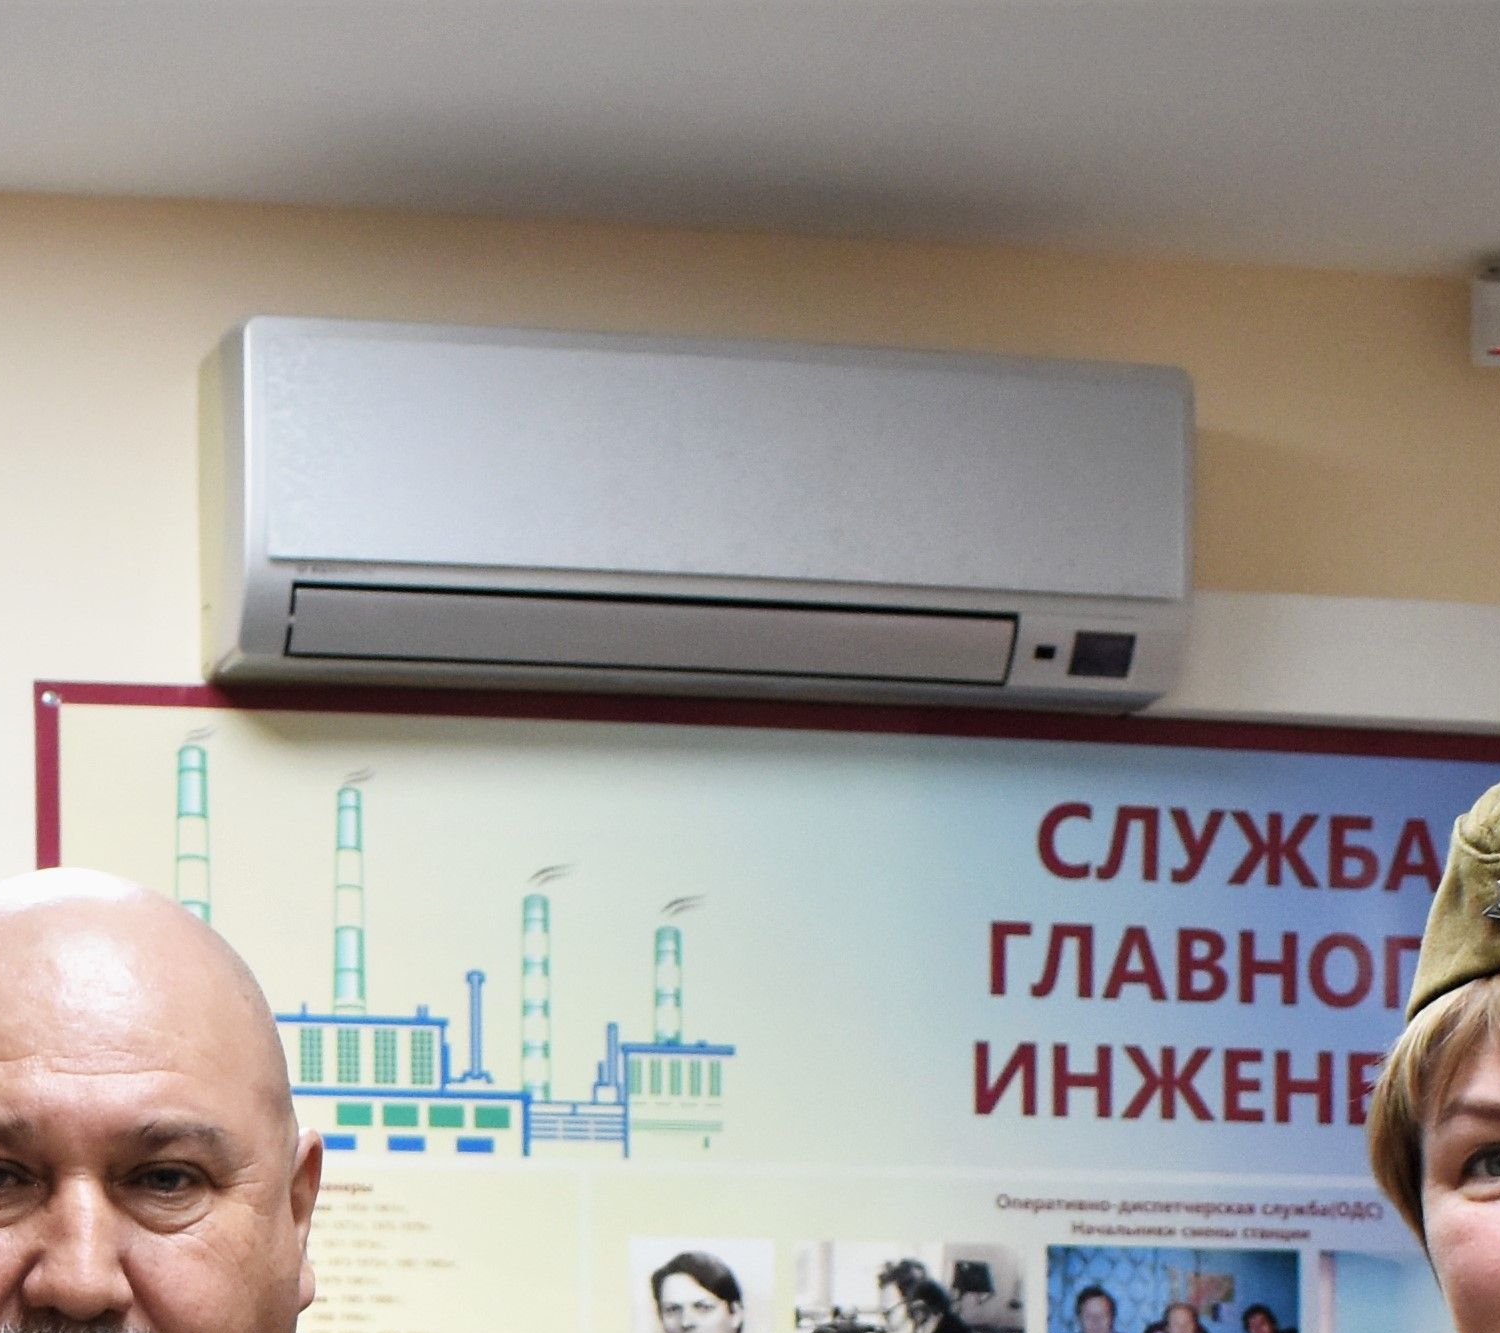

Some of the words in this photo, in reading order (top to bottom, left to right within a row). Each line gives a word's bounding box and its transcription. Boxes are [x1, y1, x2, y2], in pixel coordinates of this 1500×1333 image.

[1037, 803, 1443, 892] СЛУЖБА
[989, 921, 1423, 1009] ГЛАВНОГ
[973, 1040, 1385, 1126] ИНЖЕНЕ
